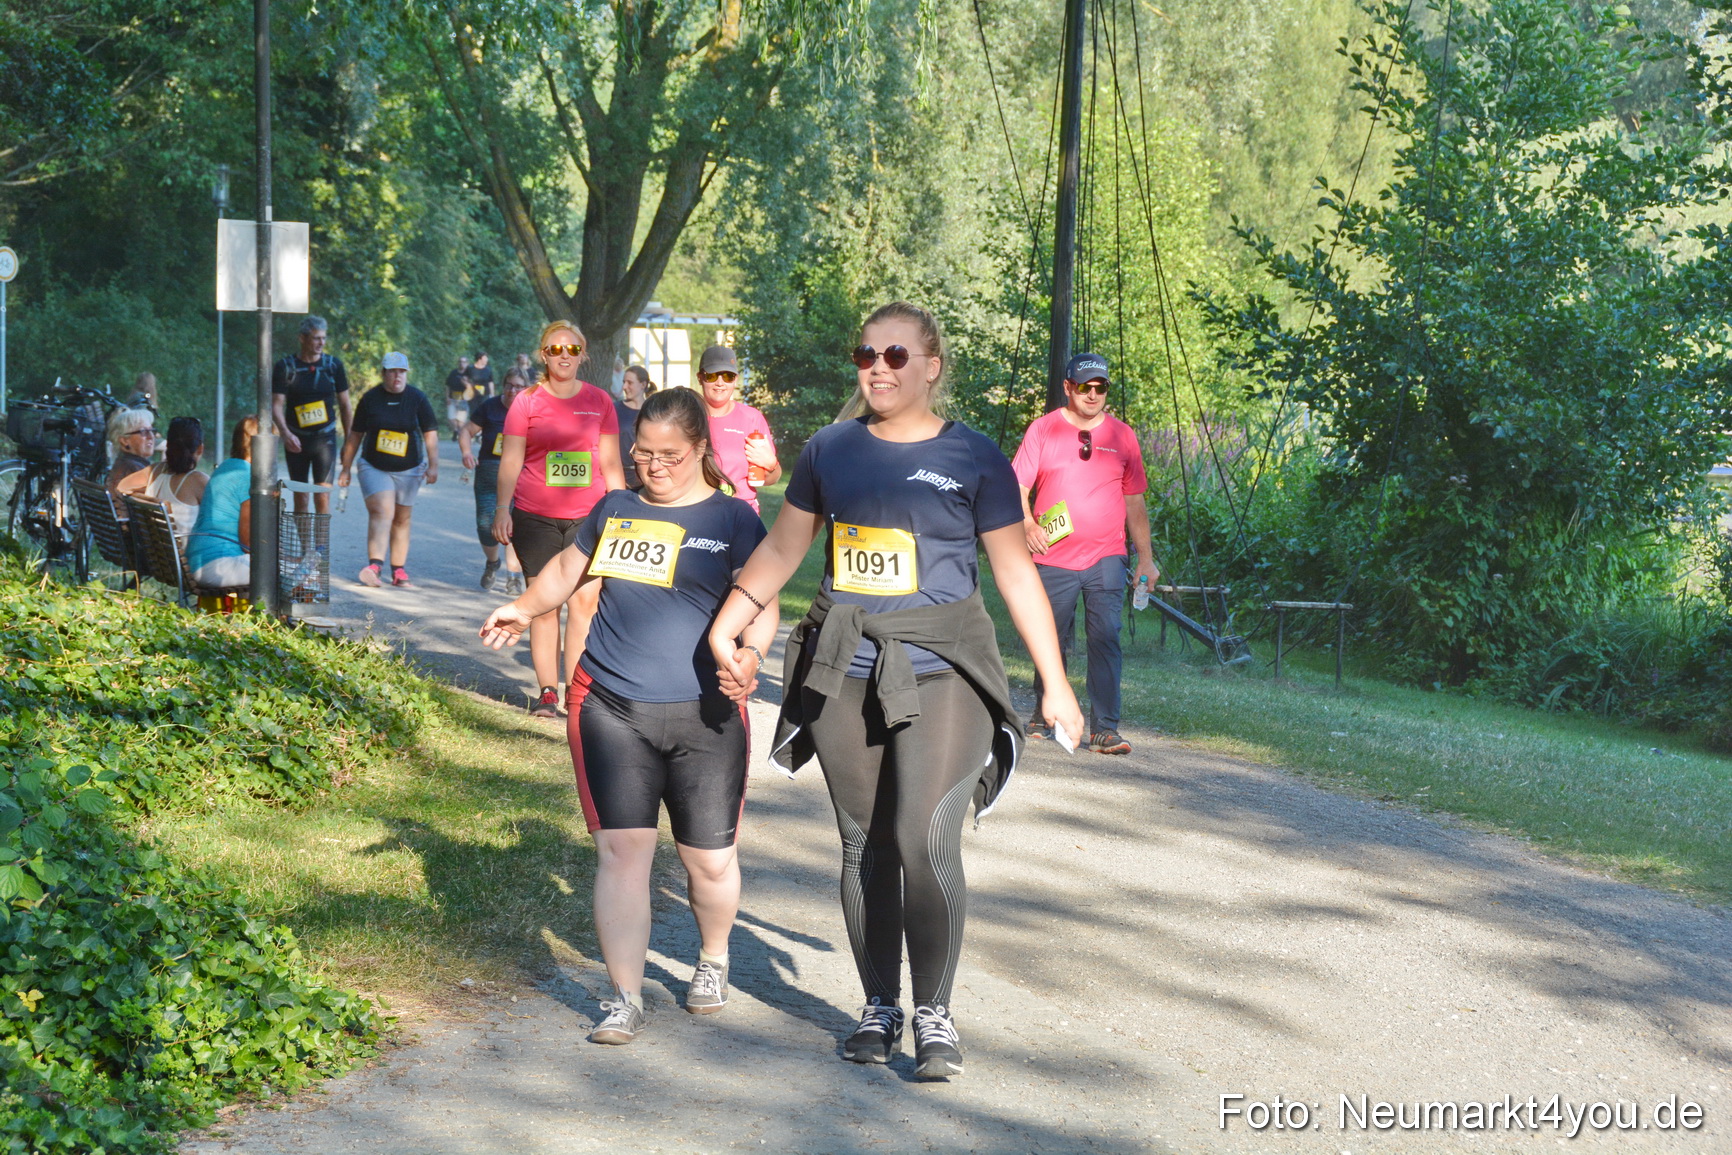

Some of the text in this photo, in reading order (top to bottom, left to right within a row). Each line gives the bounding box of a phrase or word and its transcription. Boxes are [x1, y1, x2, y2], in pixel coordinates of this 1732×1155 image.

[301, 408, 323, 421] 1710
[381, 438, 402, 449] 1711
[552, 464, 586, 477] 2059
[608, 539, 666, 566] 1083
[843, 548, 899, 576] 1091
[649, 566, 666, 575] Anita
